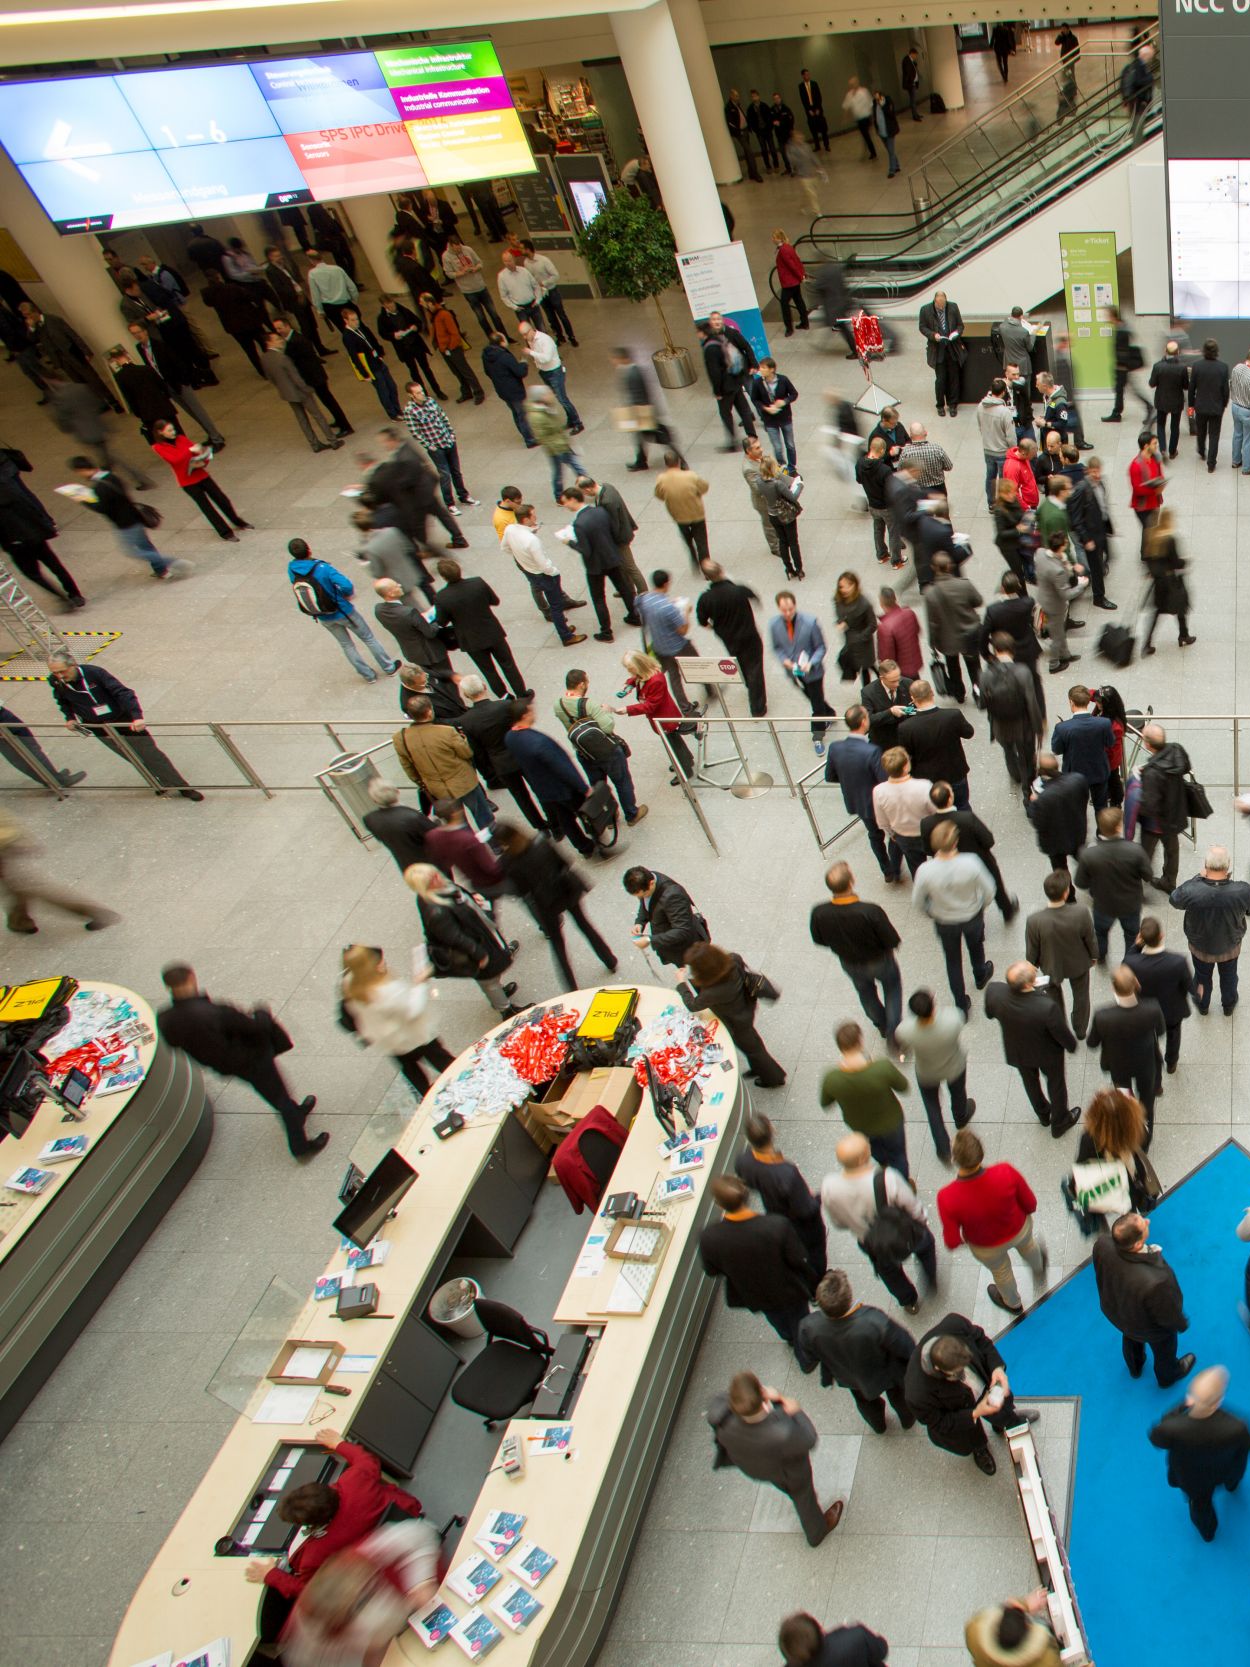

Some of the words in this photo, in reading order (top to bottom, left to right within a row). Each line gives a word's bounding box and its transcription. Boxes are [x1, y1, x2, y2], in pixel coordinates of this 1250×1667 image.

[1175, 0, 1225, 13] NCC
[160, 125, 179, 148] 1
[208, 119, 228, 143] 6
[320, 127, 348, 142] SPS
[350, 124, 375, 140] IPC
